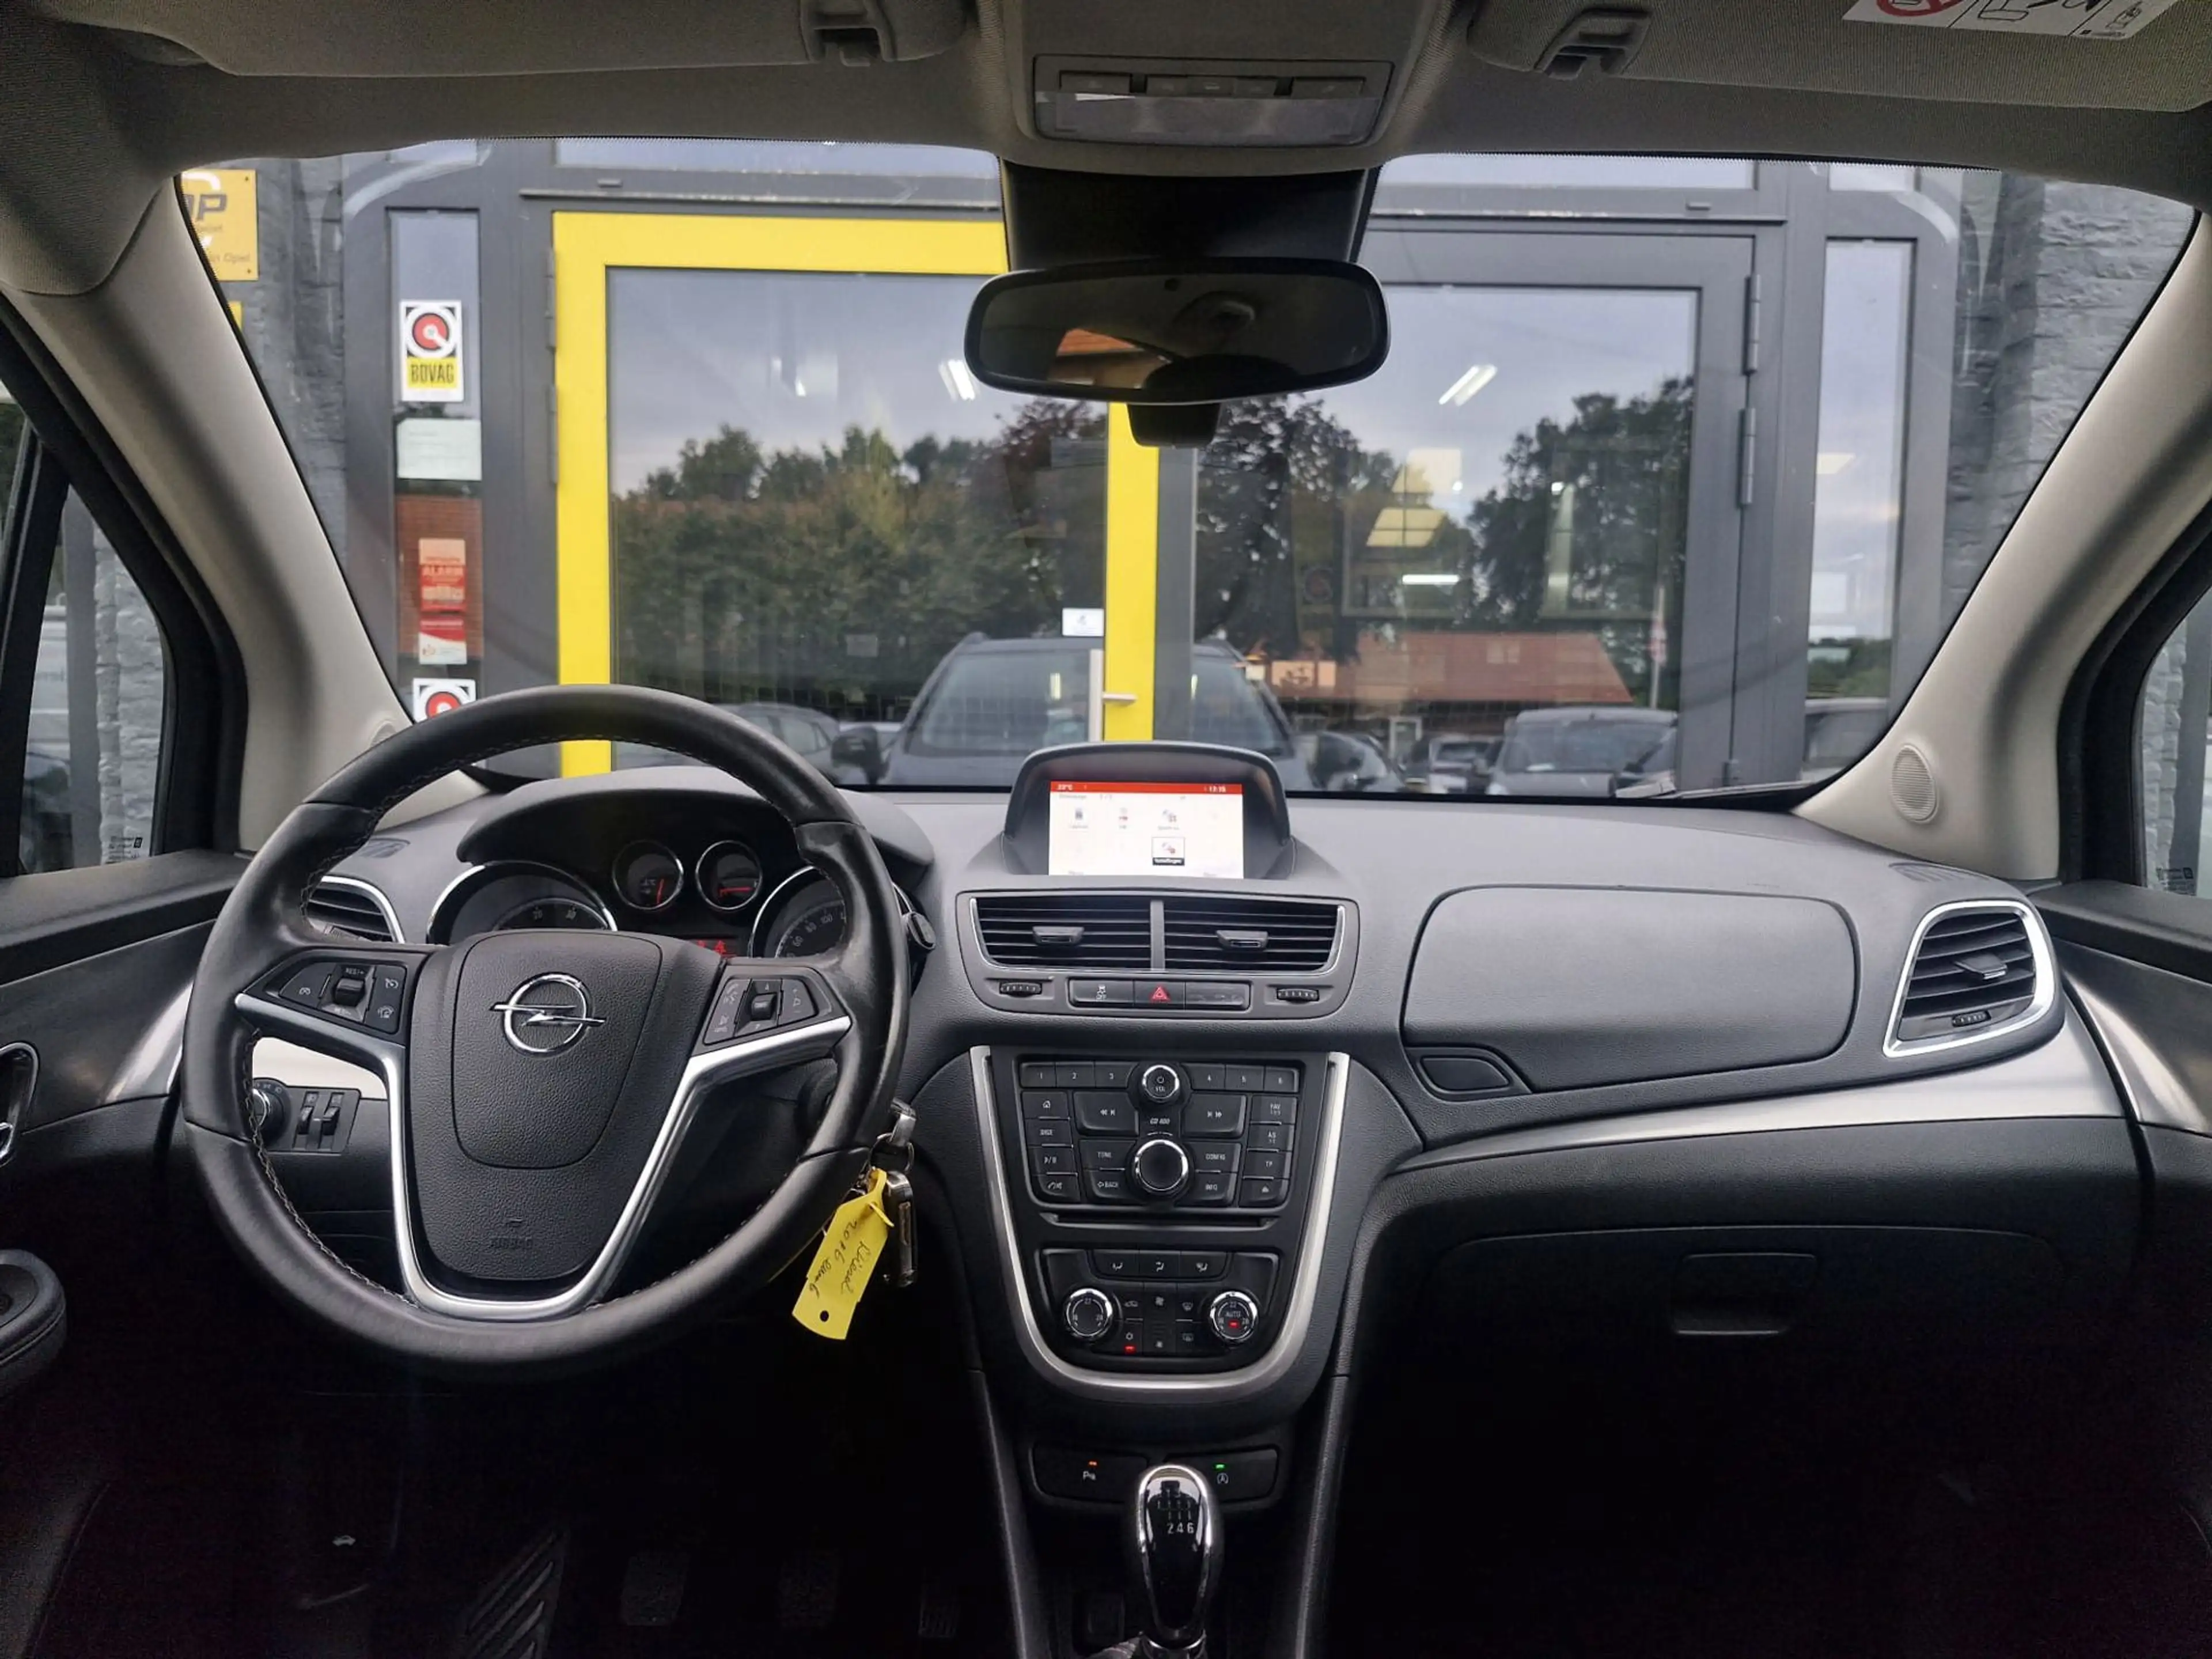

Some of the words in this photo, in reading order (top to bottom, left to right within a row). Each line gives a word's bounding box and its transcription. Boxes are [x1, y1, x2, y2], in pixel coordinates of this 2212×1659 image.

[411, 363, 454, 383] BOVAG
[1205, 1153, 1226, 1161] CONFIG
[1225, 1310, 1241, 1318] AUTO
[1167, 1522, 1174, 1534] 2
[1176, 1522, 1184, 1533] 4
[1187, 1522, 1194, 1533] 6
